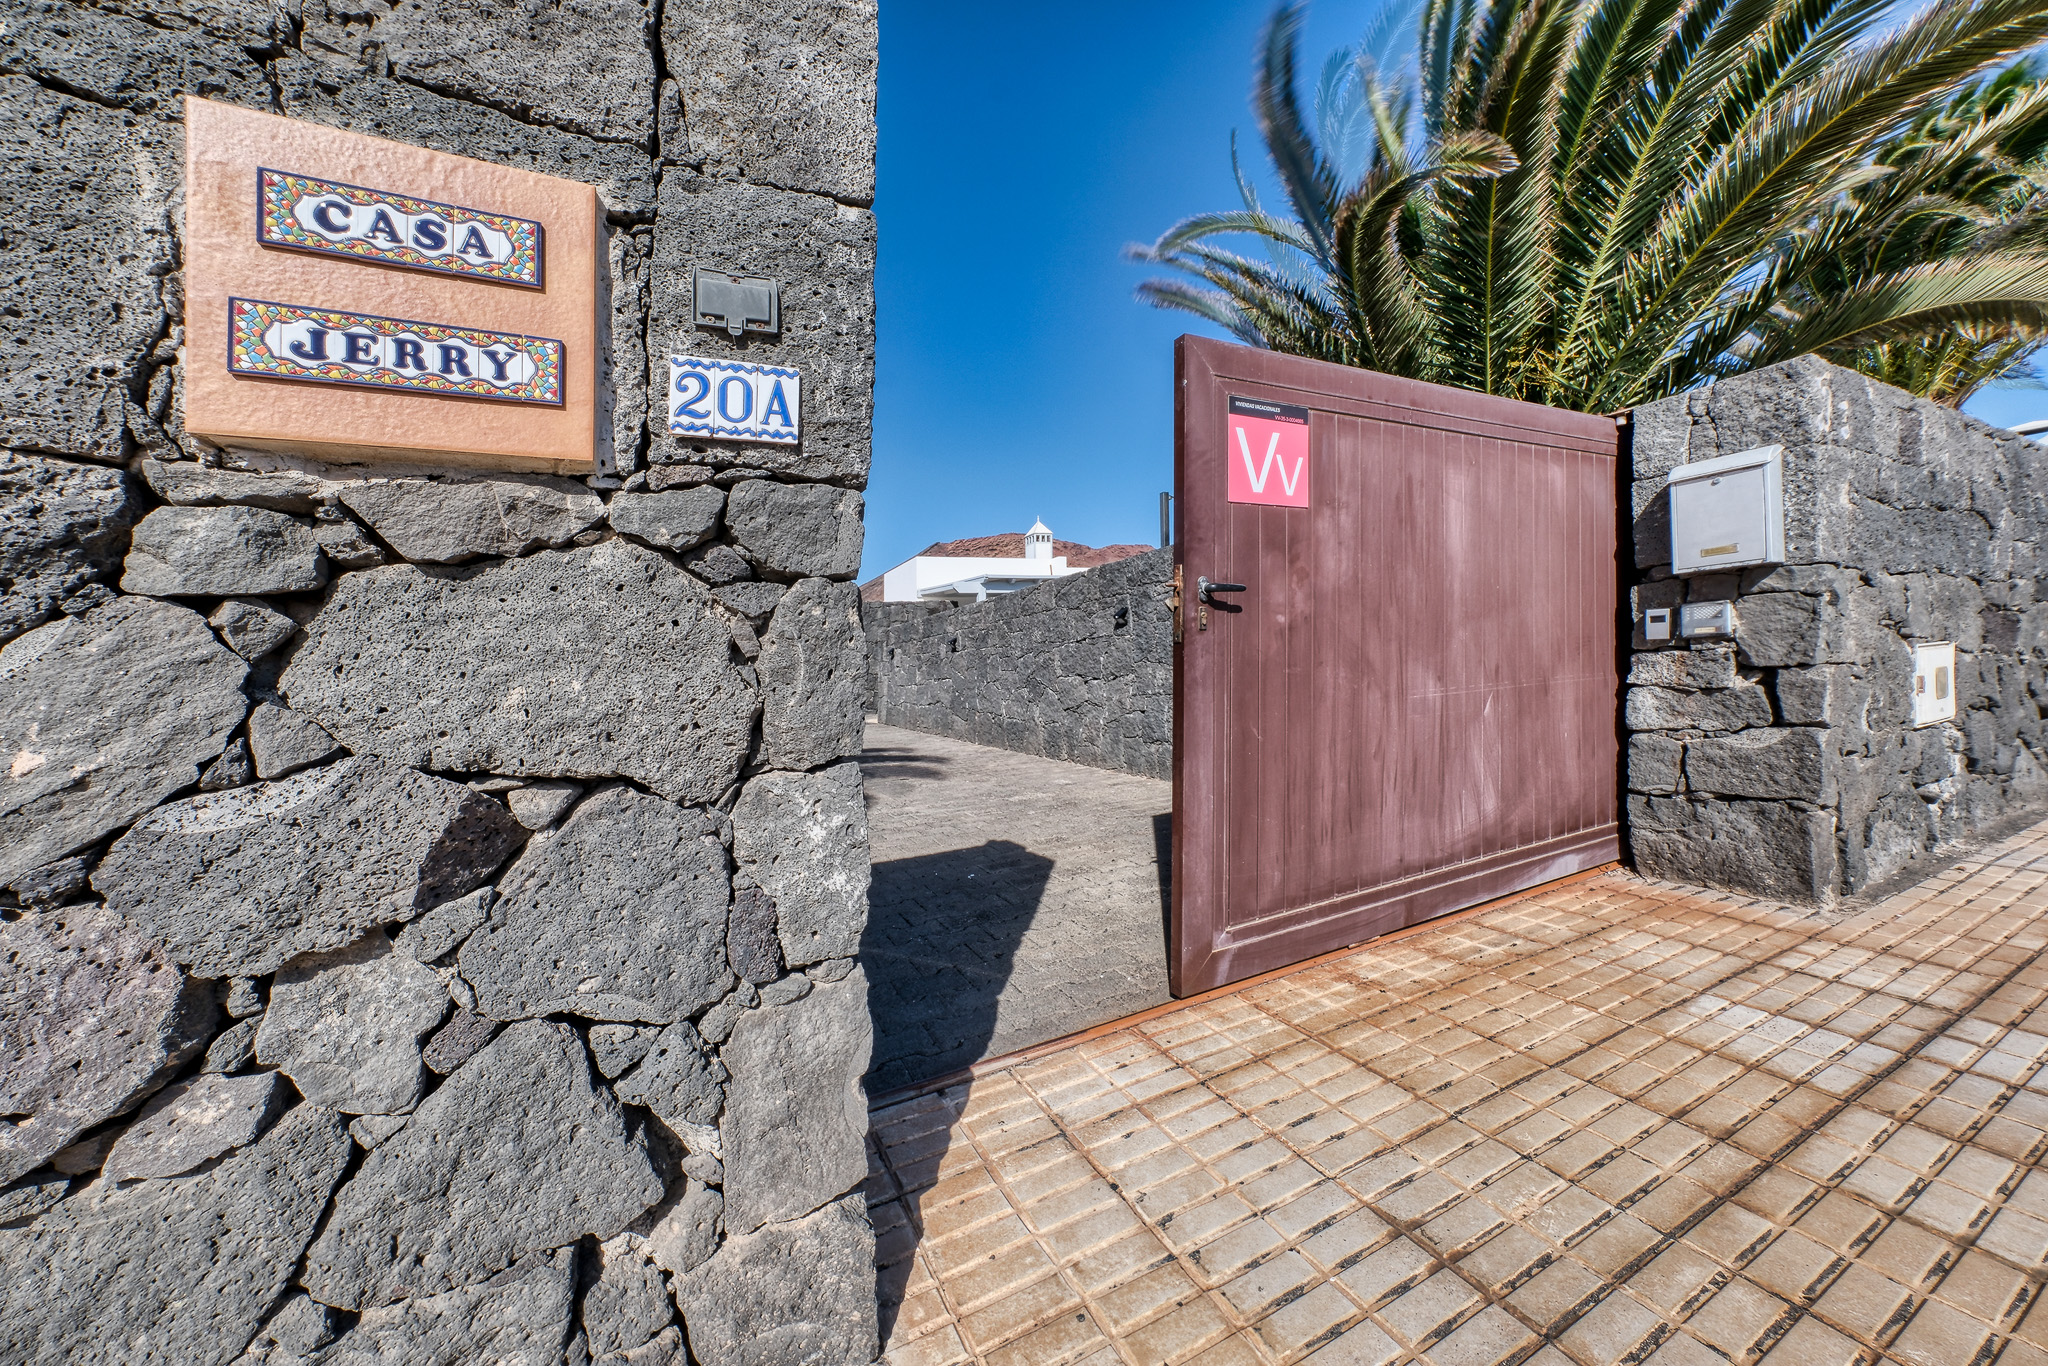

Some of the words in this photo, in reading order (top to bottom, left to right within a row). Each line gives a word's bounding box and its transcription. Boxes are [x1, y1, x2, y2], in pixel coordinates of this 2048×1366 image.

[312, 200, 493, 259] CASA
[289, 328, 518, 382] JERRY
[674, 371, 794, 428] 20A
